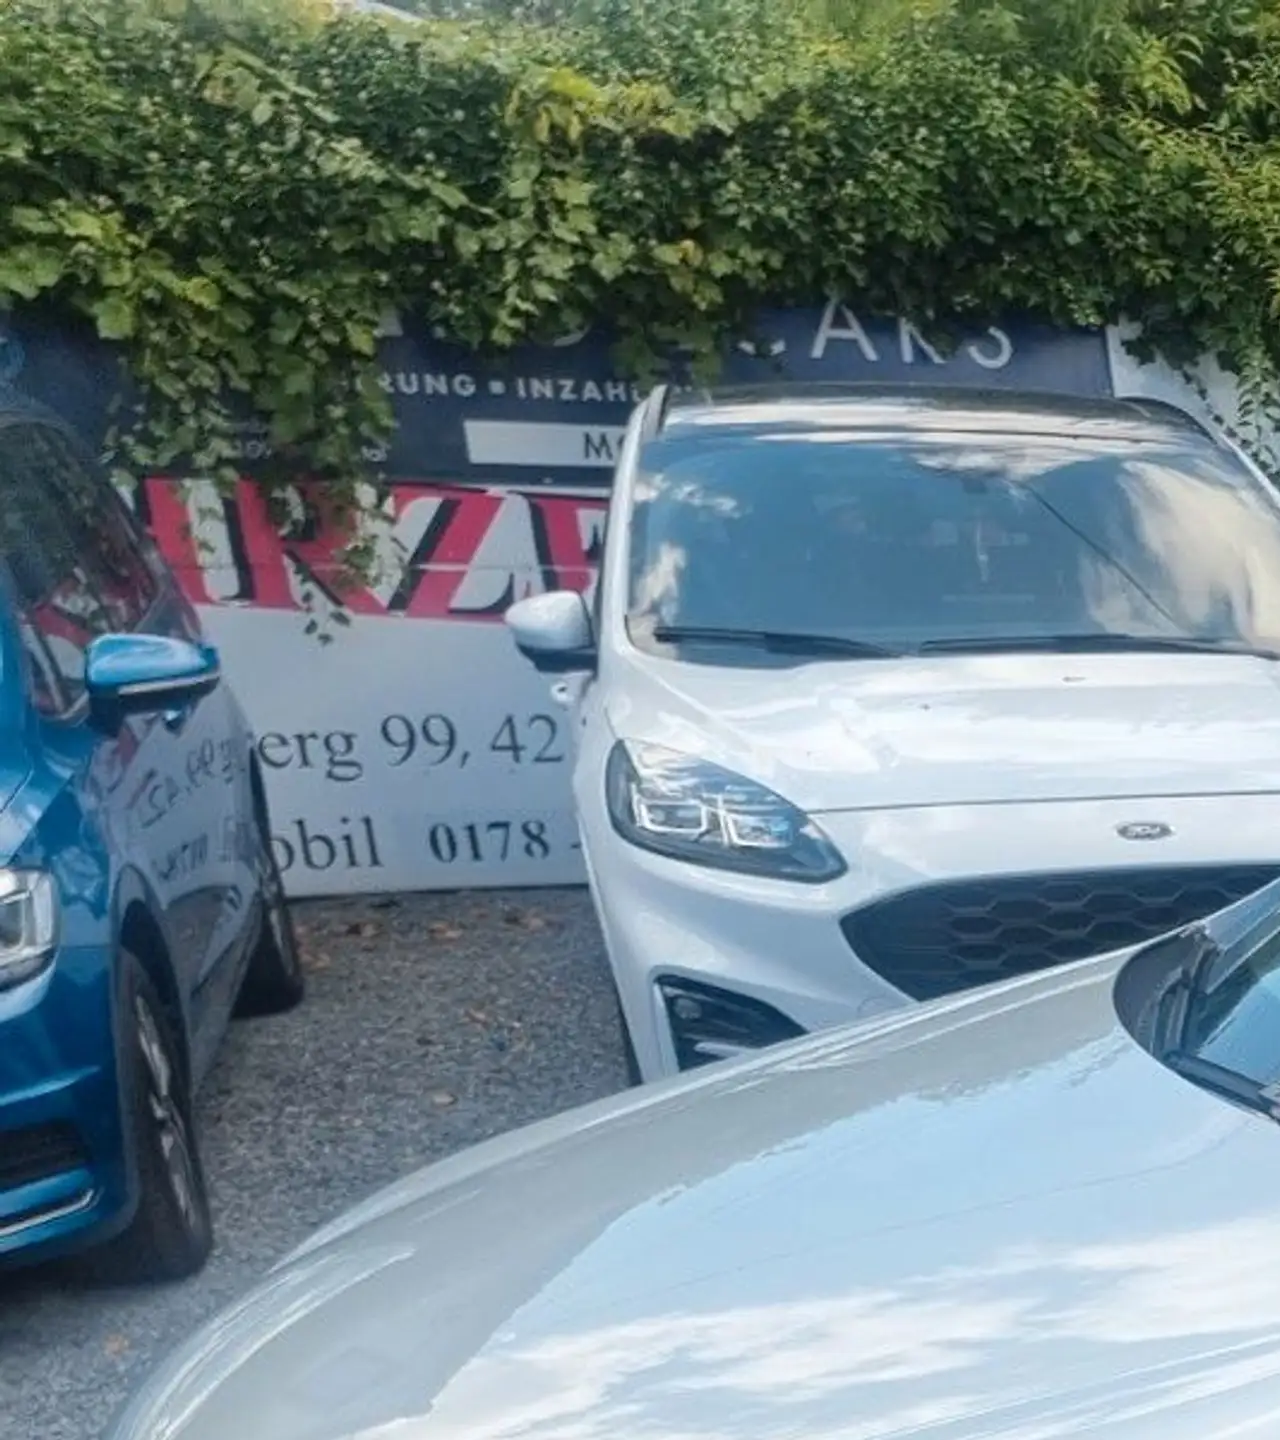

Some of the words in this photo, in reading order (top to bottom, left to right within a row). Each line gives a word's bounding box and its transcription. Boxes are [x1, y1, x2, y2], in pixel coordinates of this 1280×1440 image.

[380, 713, 470, 768] 99,
[489, 713, 565, 764] 42
[428, 819, 551, 864] 0178
